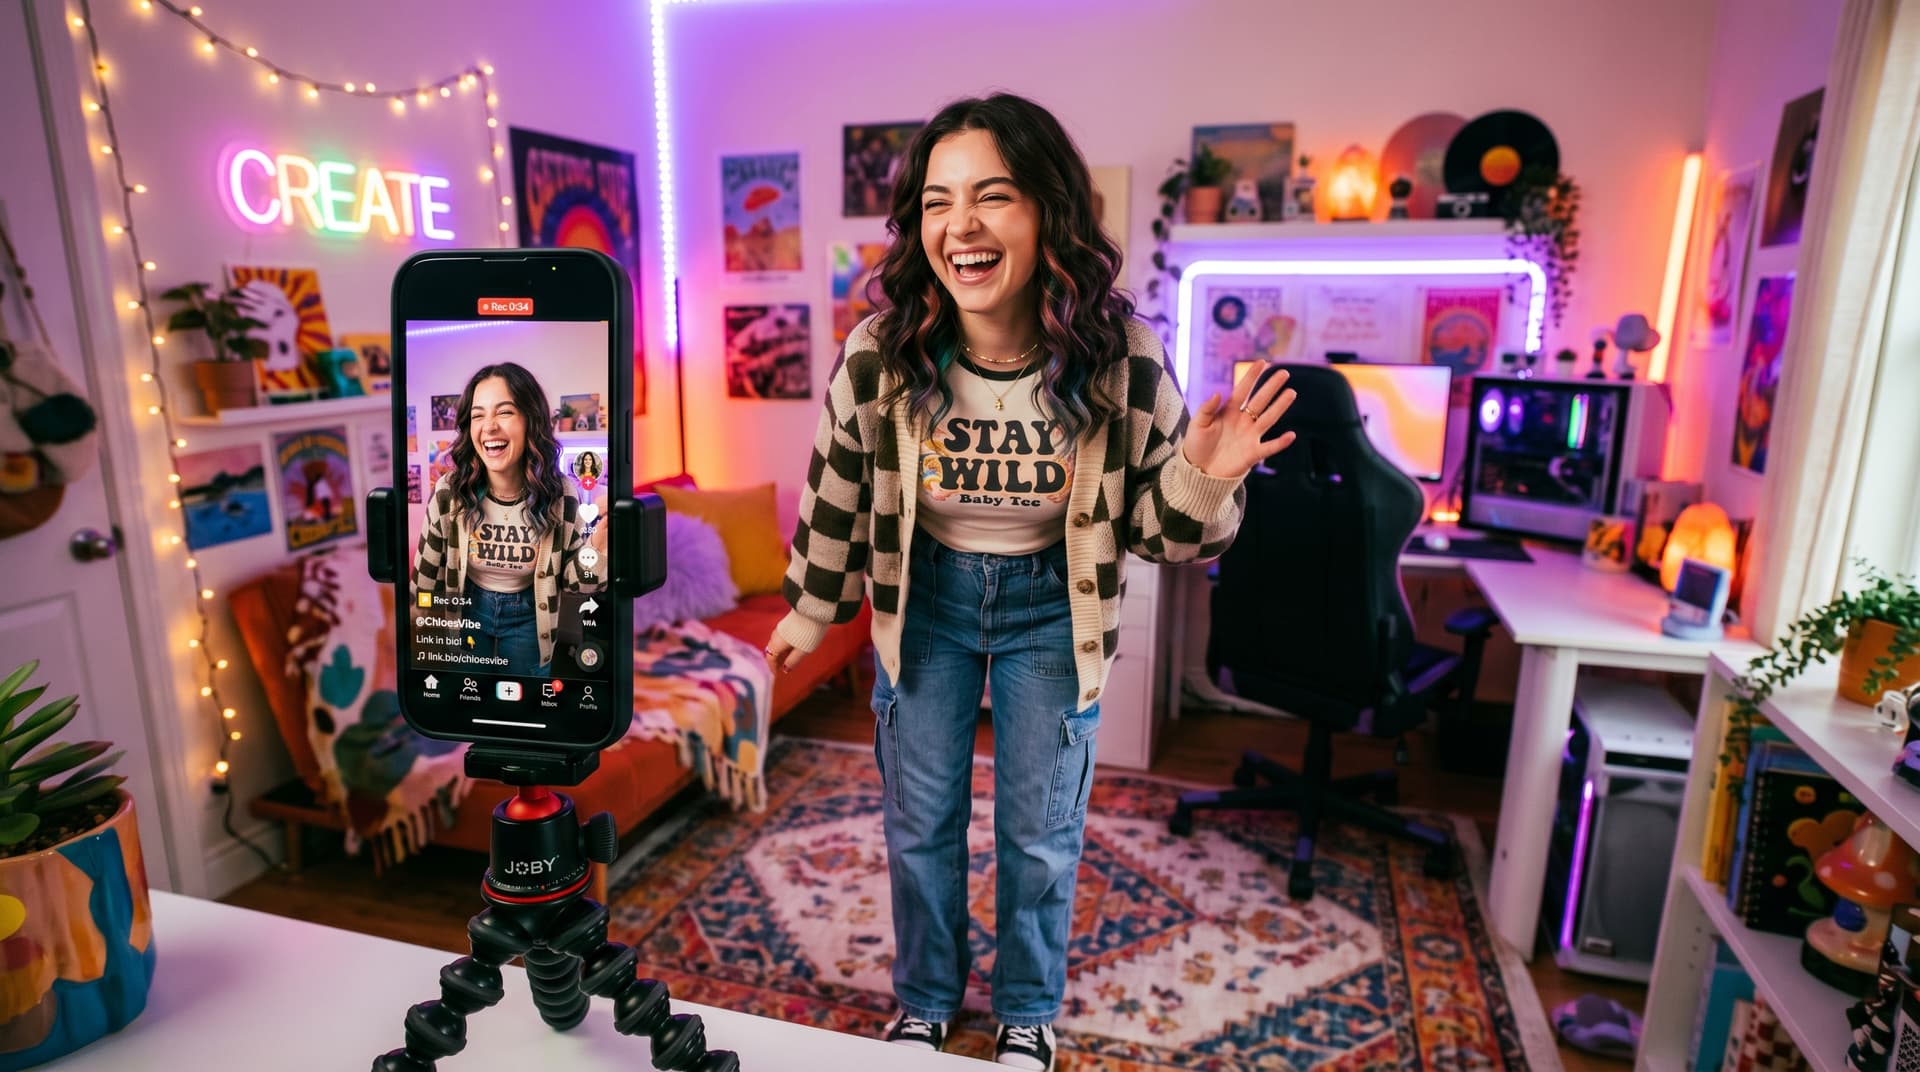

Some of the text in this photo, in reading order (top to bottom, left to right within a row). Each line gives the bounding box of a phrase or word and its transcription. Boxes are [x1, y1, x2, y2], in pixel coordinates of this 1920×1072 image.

[229, 148, 456, 241] CREATE
[491, 302, 508, 311] Rec
[943, 417, 1059, 455] STAY
[938, 456, 1067, 494] WILD
[959, 494, 1004, 507] Baby
[480, 523, 531, 544] STAY
[477, 542, 536, 563] WILD
[433, 595, 449, 605] Rec
[415, 616, 481, 630] @ChloesVibe
[416, 634, 434, 645] Link
[435, 635, 444, 645] in
[423, 691, 440, 699] Home
[459, 694, 481, 702] Friends
[504, 856, 556, 876] JOBY
